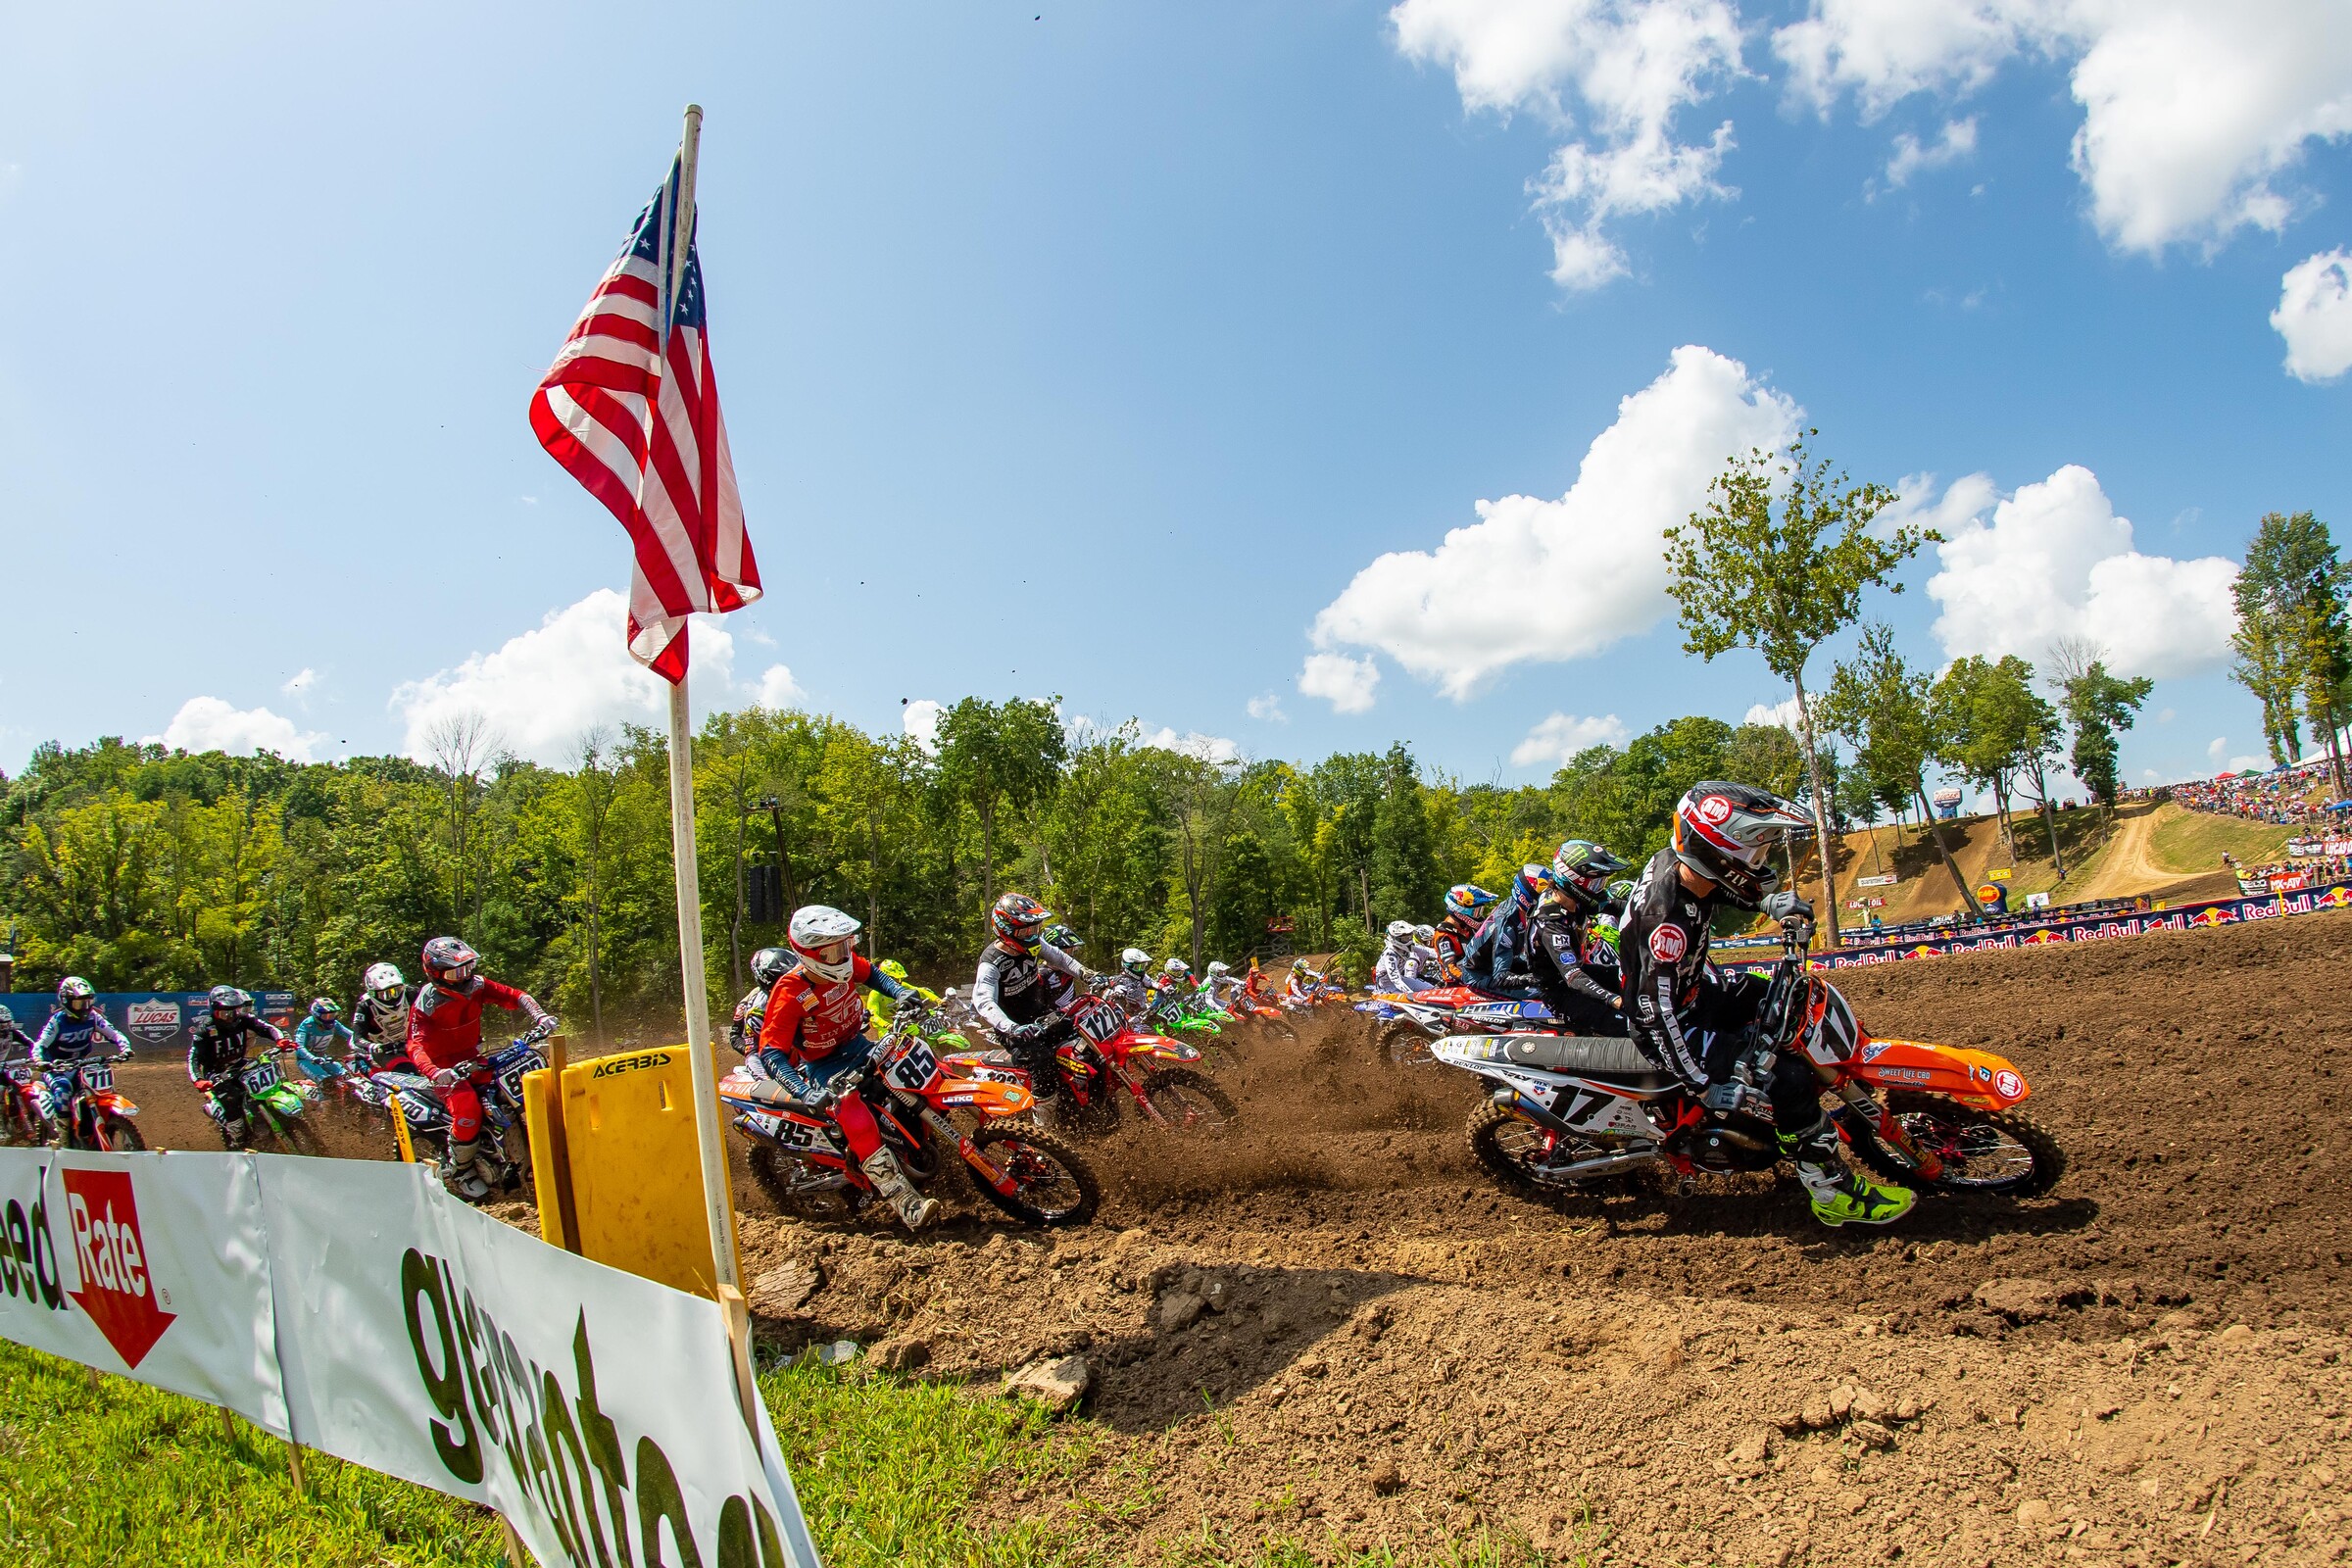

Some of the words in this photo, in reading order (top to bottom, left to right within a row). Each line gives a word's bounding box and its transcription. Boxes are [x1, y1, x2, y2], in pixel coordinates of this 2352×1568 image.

[1724, 869, 1748, 887] FLY
[2271, 876, 2303, 892] MX-ATV
[1849, 900, 1871, 908] LUCS
[2242, 899, 2278, 921] Red
[2279, 894, 2313, 916] Bull
[1555, 935, 1569, 944] MX
[2073, 926, 2106, 942] Red
[2107, 919, 2140, 938] Bull
[1952, 939, 1984, 956] Red
[1984, 935, 2017, 952] Bull
[1835, 954, 1865, 969] Red
[1866, 950, 1896, 966] Bull
[134, 1012, 177, 1024] LUCAS
[1084, 1005, 1120, 1043] 122
[1472, 1014, 1506, 1025] DUNLOP
[216, 1031, 244, 1052] FLY
[819, 1028, 840, 1040] FLY
[506, 1059, 521, 1071] LUCAS
[895, 1040, 937, 1091] 85
[1452, 1059, 1487, 1071] DUNLOP
[1878, 1066, 1901, 1077] SWEET
[1902, 1068, 1916, 1080] LIFE
[1917, 1071, 1932, 1080] CBD
[85, 1069, 114, 1089] 711
[248, 1067, 278, 1095] 647
[942, 1095, 974, 1103] LETKO
[1548, 1084, 1617, 1126] 17
[879, 1112, 896, 1131] EBC
[774, 1119, 815, 1148] 85
[68, 1192, 146, 1298] Rate
